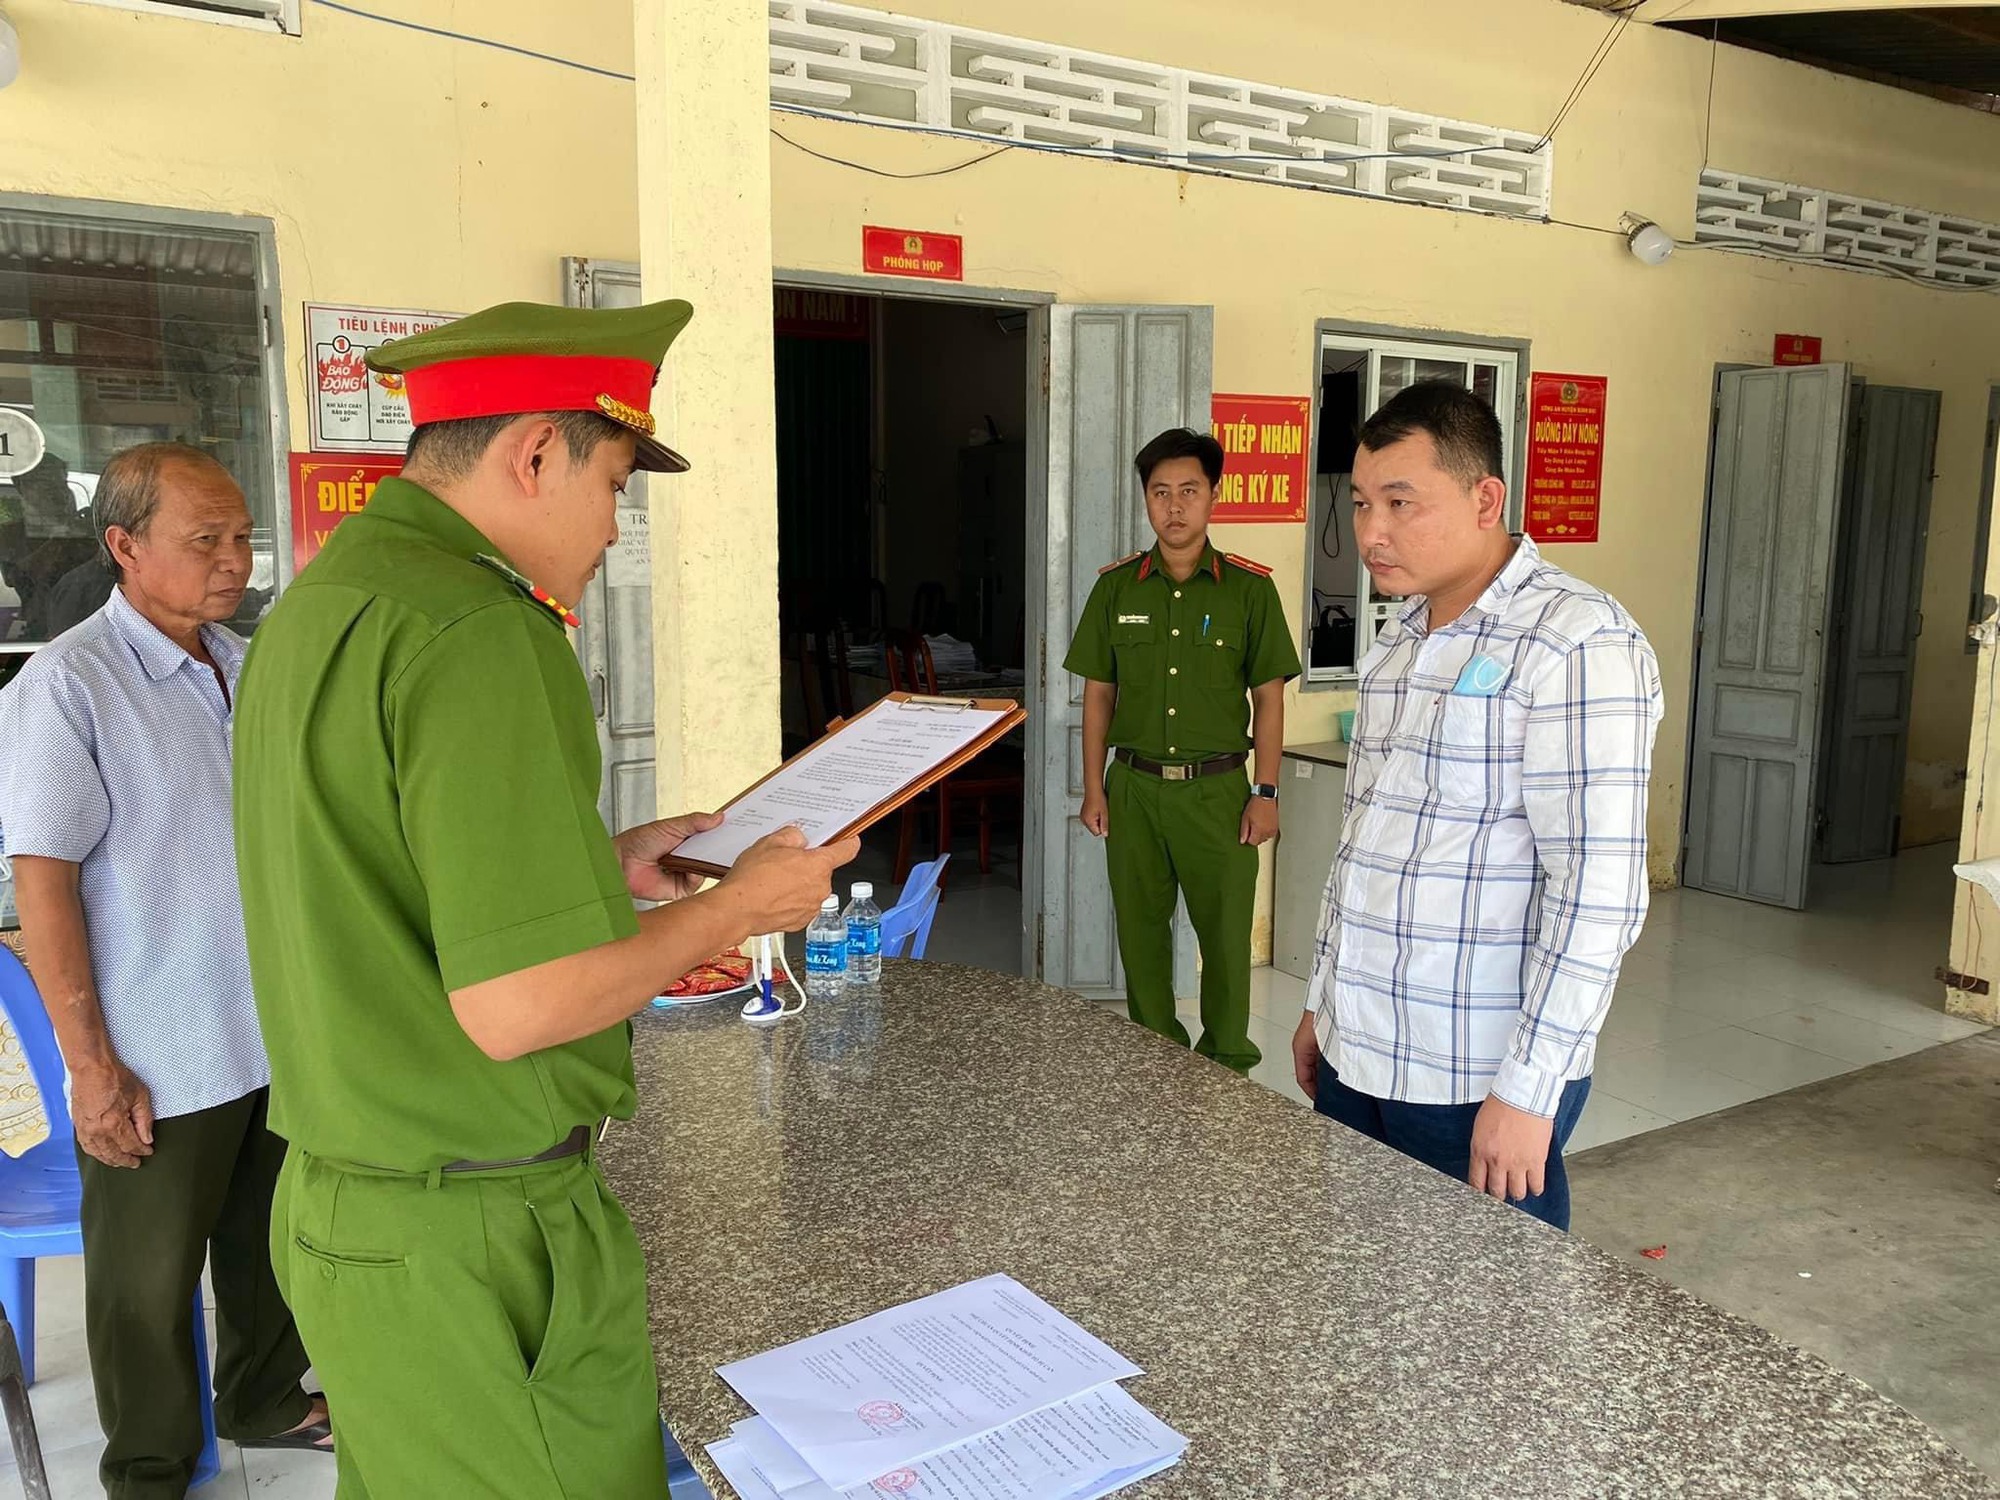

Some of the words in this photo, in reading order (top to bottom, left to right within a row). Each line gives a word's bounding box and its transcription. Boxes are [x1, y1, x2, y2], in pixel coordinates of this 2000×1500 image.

[883, 255, 920, 270] PHÒNG
[922, 260, 944, 274] HỌP
[338, 316, 368, 332] TIÊU
[374, 319, 408, 336] LỆNH
[322, 377, 359, 393] ĐỘNG
[1223, 414, 1257, 453] TIẾP
[1261, 420, 1302, 460] NHẬN
[1248, 470, 1269, 503] KÝ
[1272, 474, 1290, 503] XE
